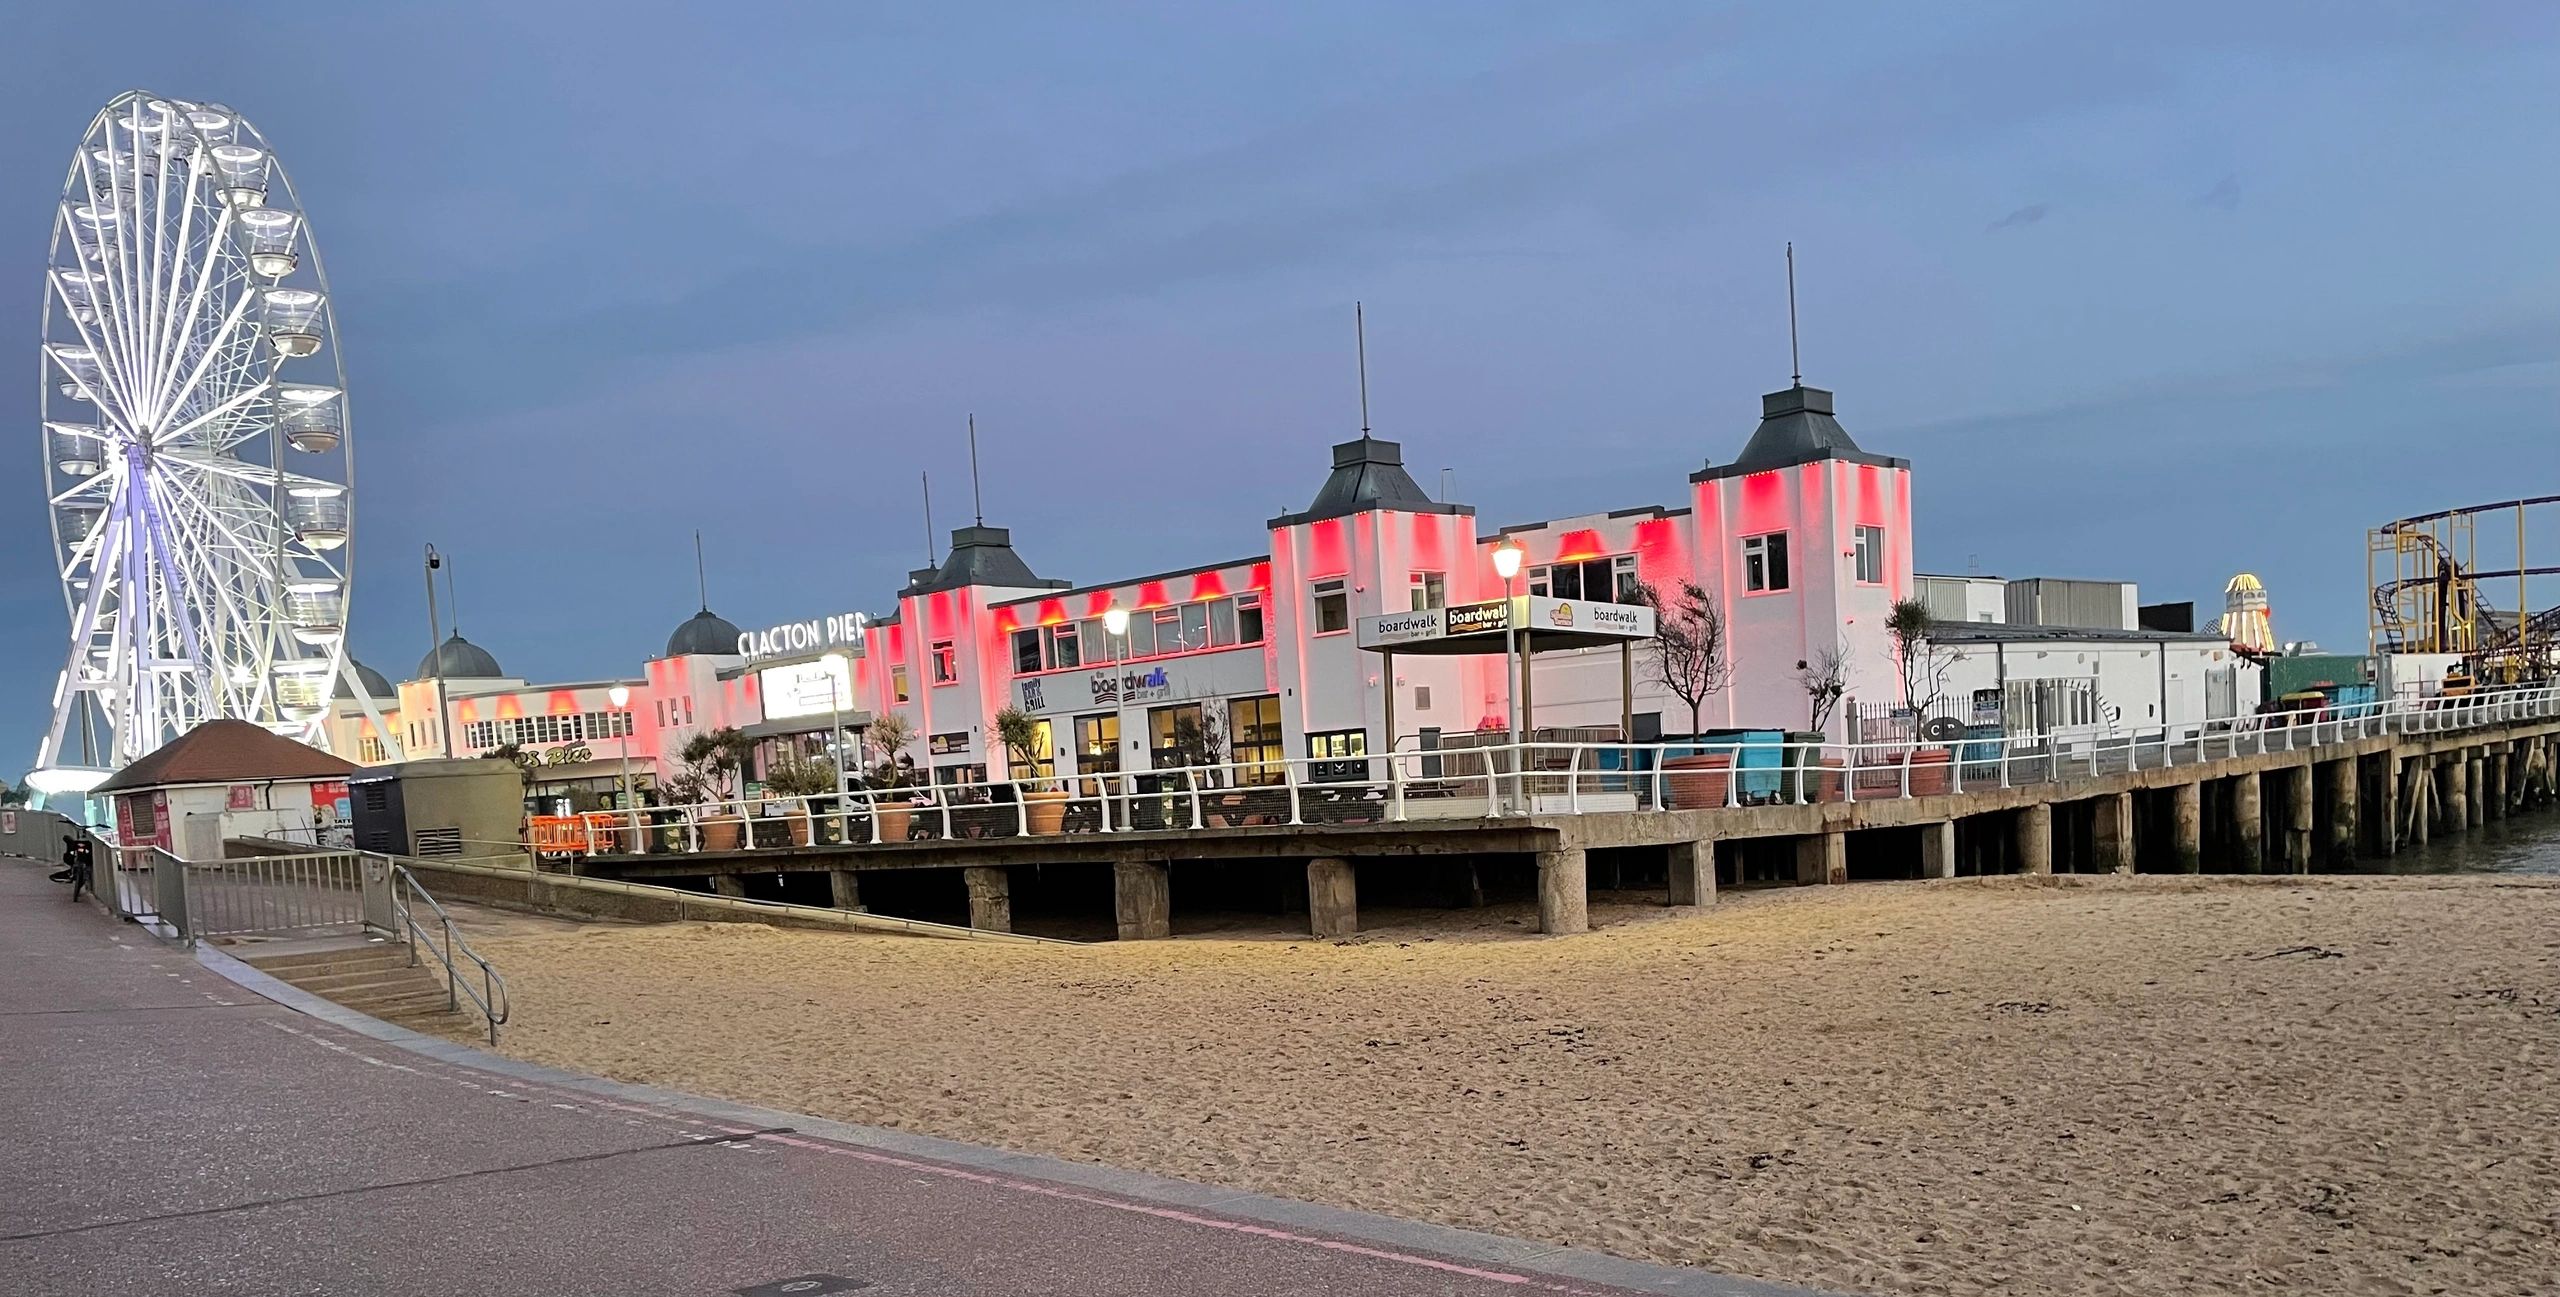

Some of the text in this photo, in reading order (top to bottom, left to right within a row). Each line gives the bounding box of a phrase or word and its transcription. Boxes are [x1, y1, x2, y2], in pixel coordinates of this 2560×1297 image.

[1379, 614, 1437, 633] boardwalk
[1594, 606, 1638, 623] boardwalk
[737, 611, 866, 657] CLACTON PIER
[1025, 696, 1045, 712] GRILL
